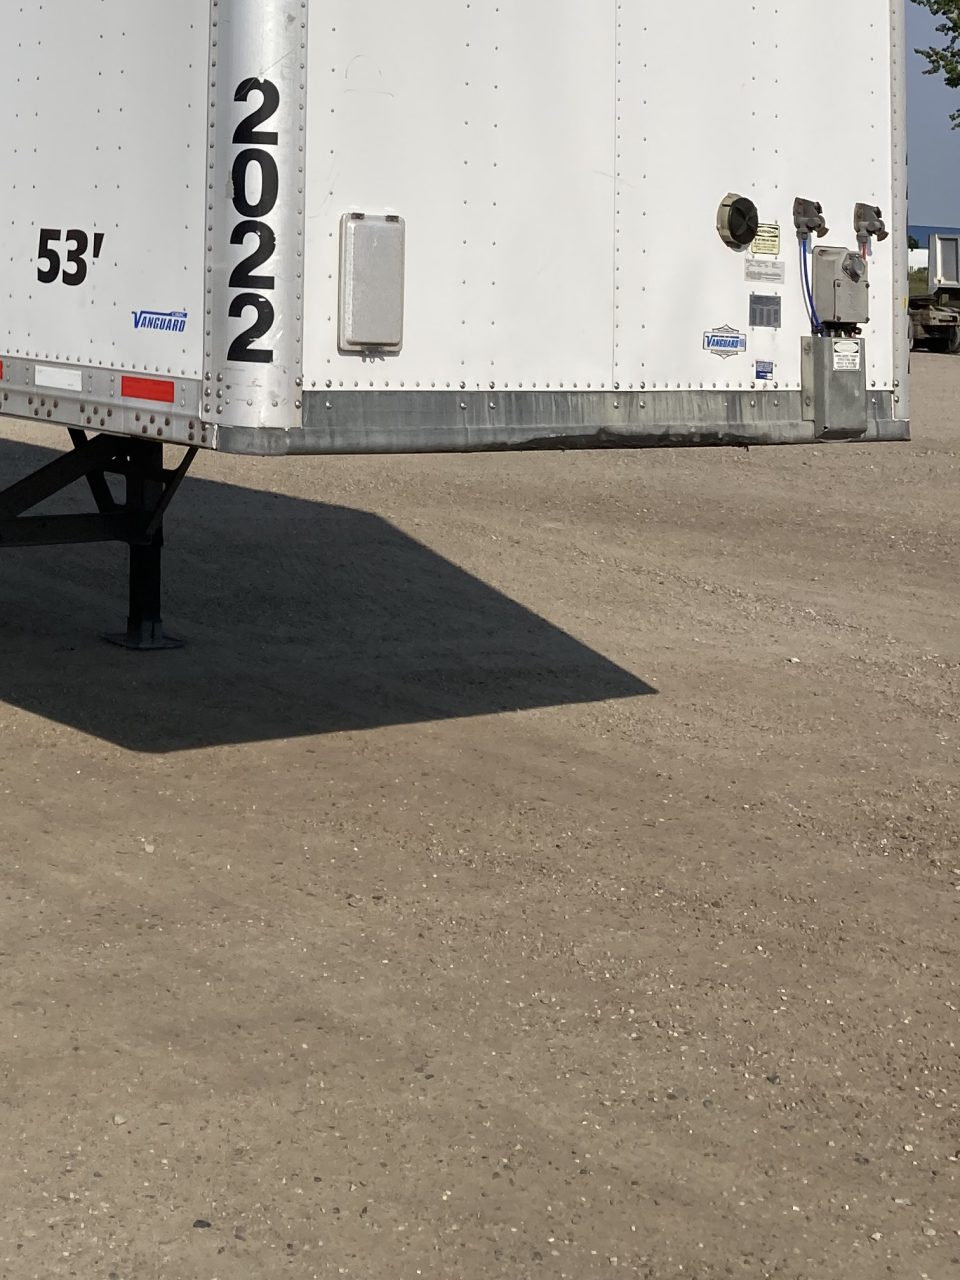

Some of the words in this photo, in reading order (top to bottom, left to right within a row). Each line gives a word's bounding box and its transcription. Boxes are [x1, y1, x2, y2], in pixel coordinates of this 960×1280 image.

[227, 77, 280, 363] 2022
[37, 228, 105, 286] 53'
[131, 310, 186, 332] VANGUARD
[705, 335, 739, 348] VANGUARD
